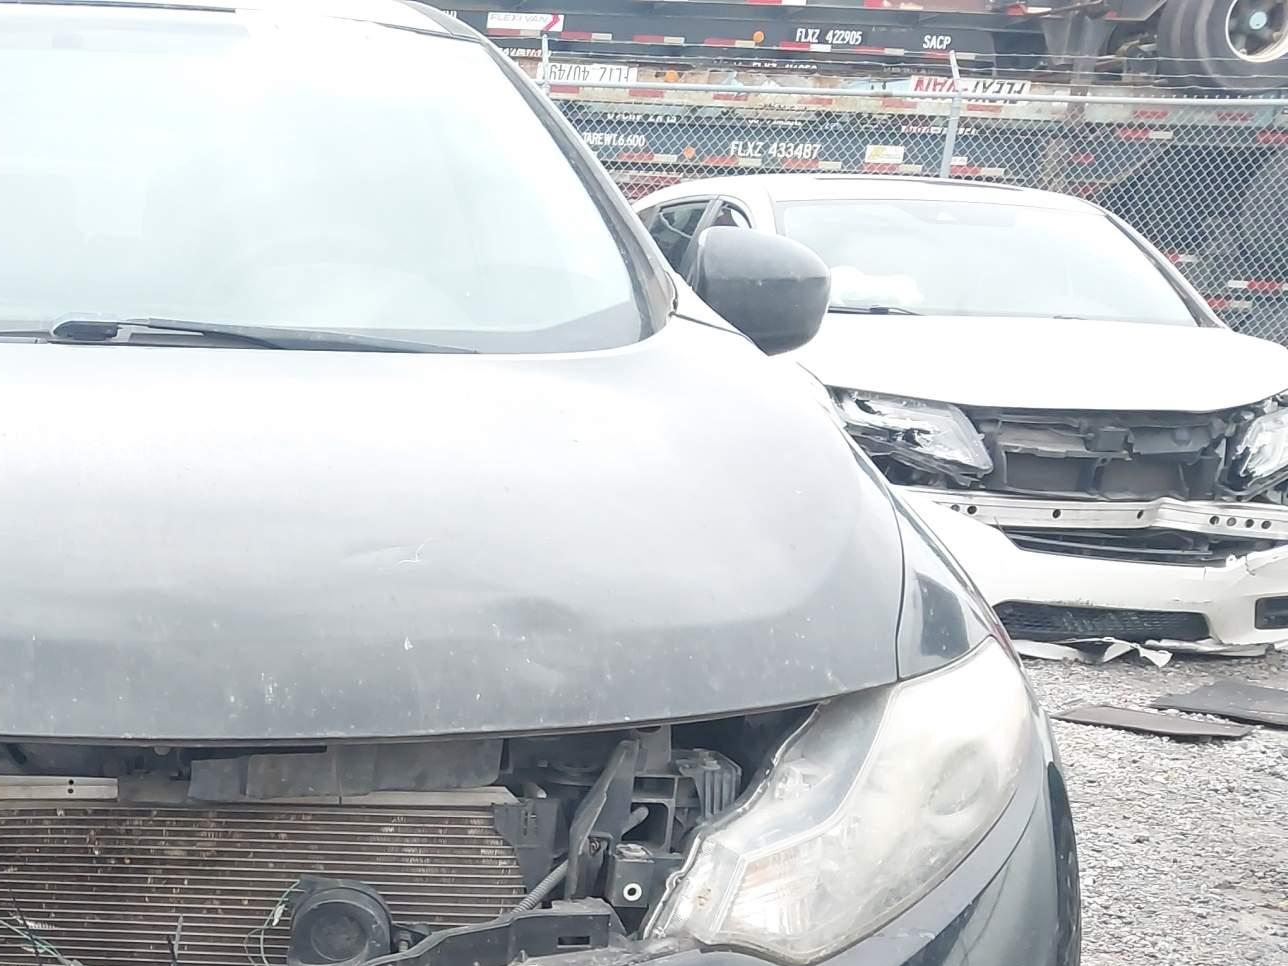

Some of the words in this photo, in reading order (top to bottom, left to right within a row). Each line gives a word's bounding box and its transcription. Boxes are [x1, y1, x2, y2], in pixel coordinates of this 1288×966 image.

[795, 28, 820, 43] FLXZ
[825, 29, 863, 45] 422905
[922, 35, 951, 50] SACP
[730, 141, 764, 157] FLXZ
[768, 142, 820, 160] 433487
